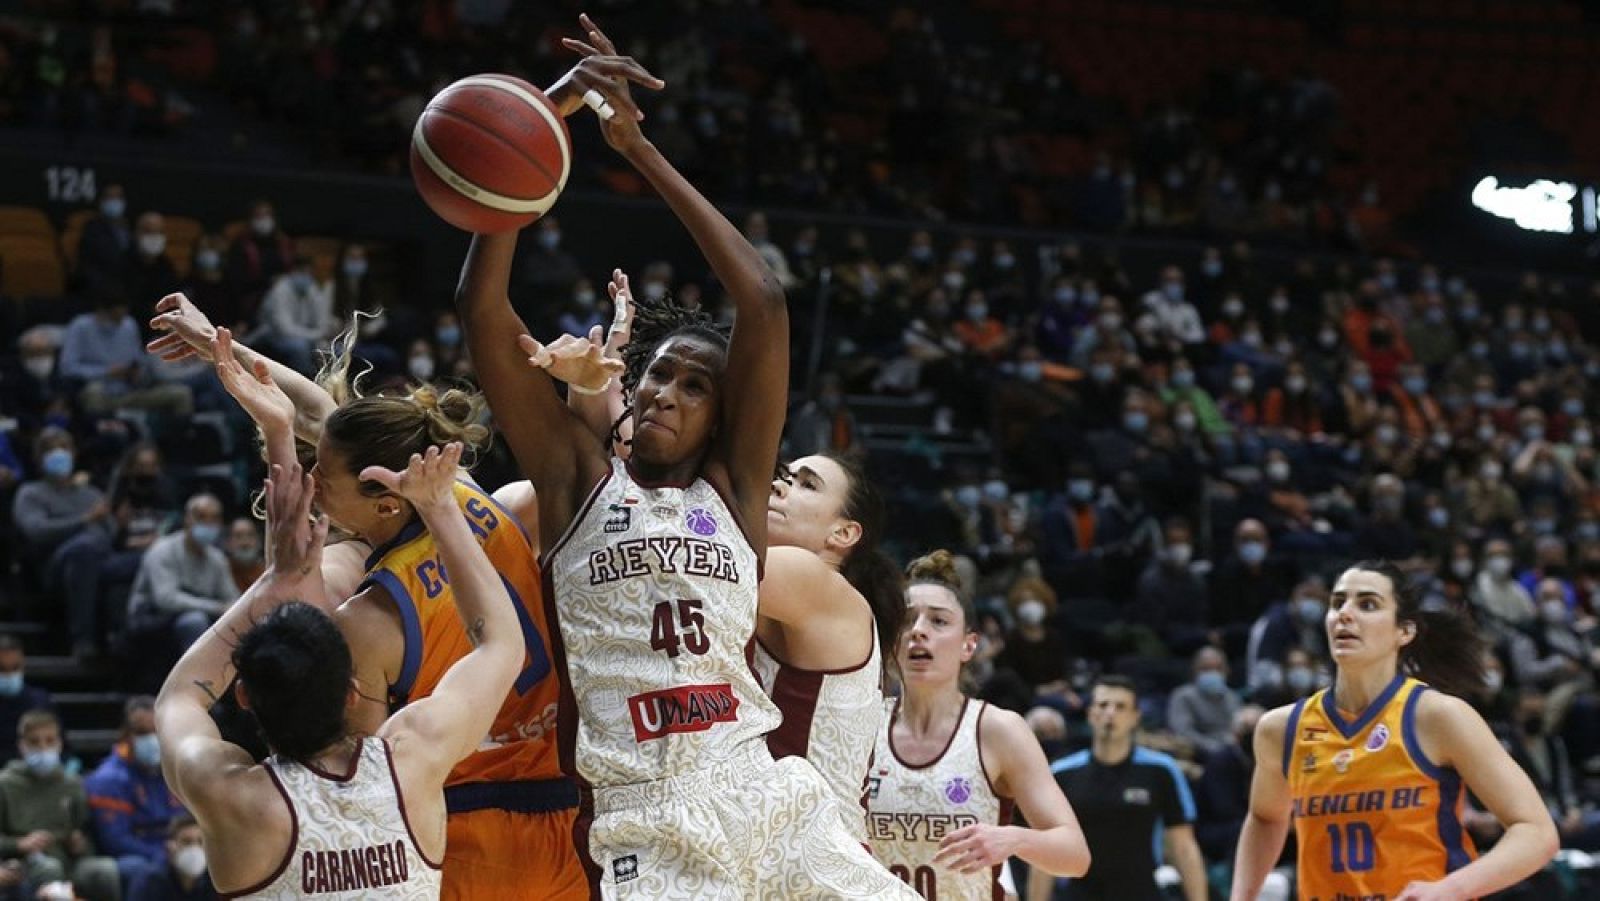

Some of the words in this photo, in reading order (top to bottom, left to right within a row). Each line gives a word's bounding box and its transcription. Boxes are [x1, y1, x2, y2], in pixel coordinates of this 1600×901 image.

[45, 167, 96, 202] 124
[589, 537, 740, 586] REYER
[650, 600, 711, 659] 45
[638, 691, 733, 733] UMANA
[1291, 788, 1386, 818] LENCIA
[1392, 785, 1429, 809] BC
[302, 839, 409, 896] CARANGELO
[1327, 821, 1376, 873] 10
